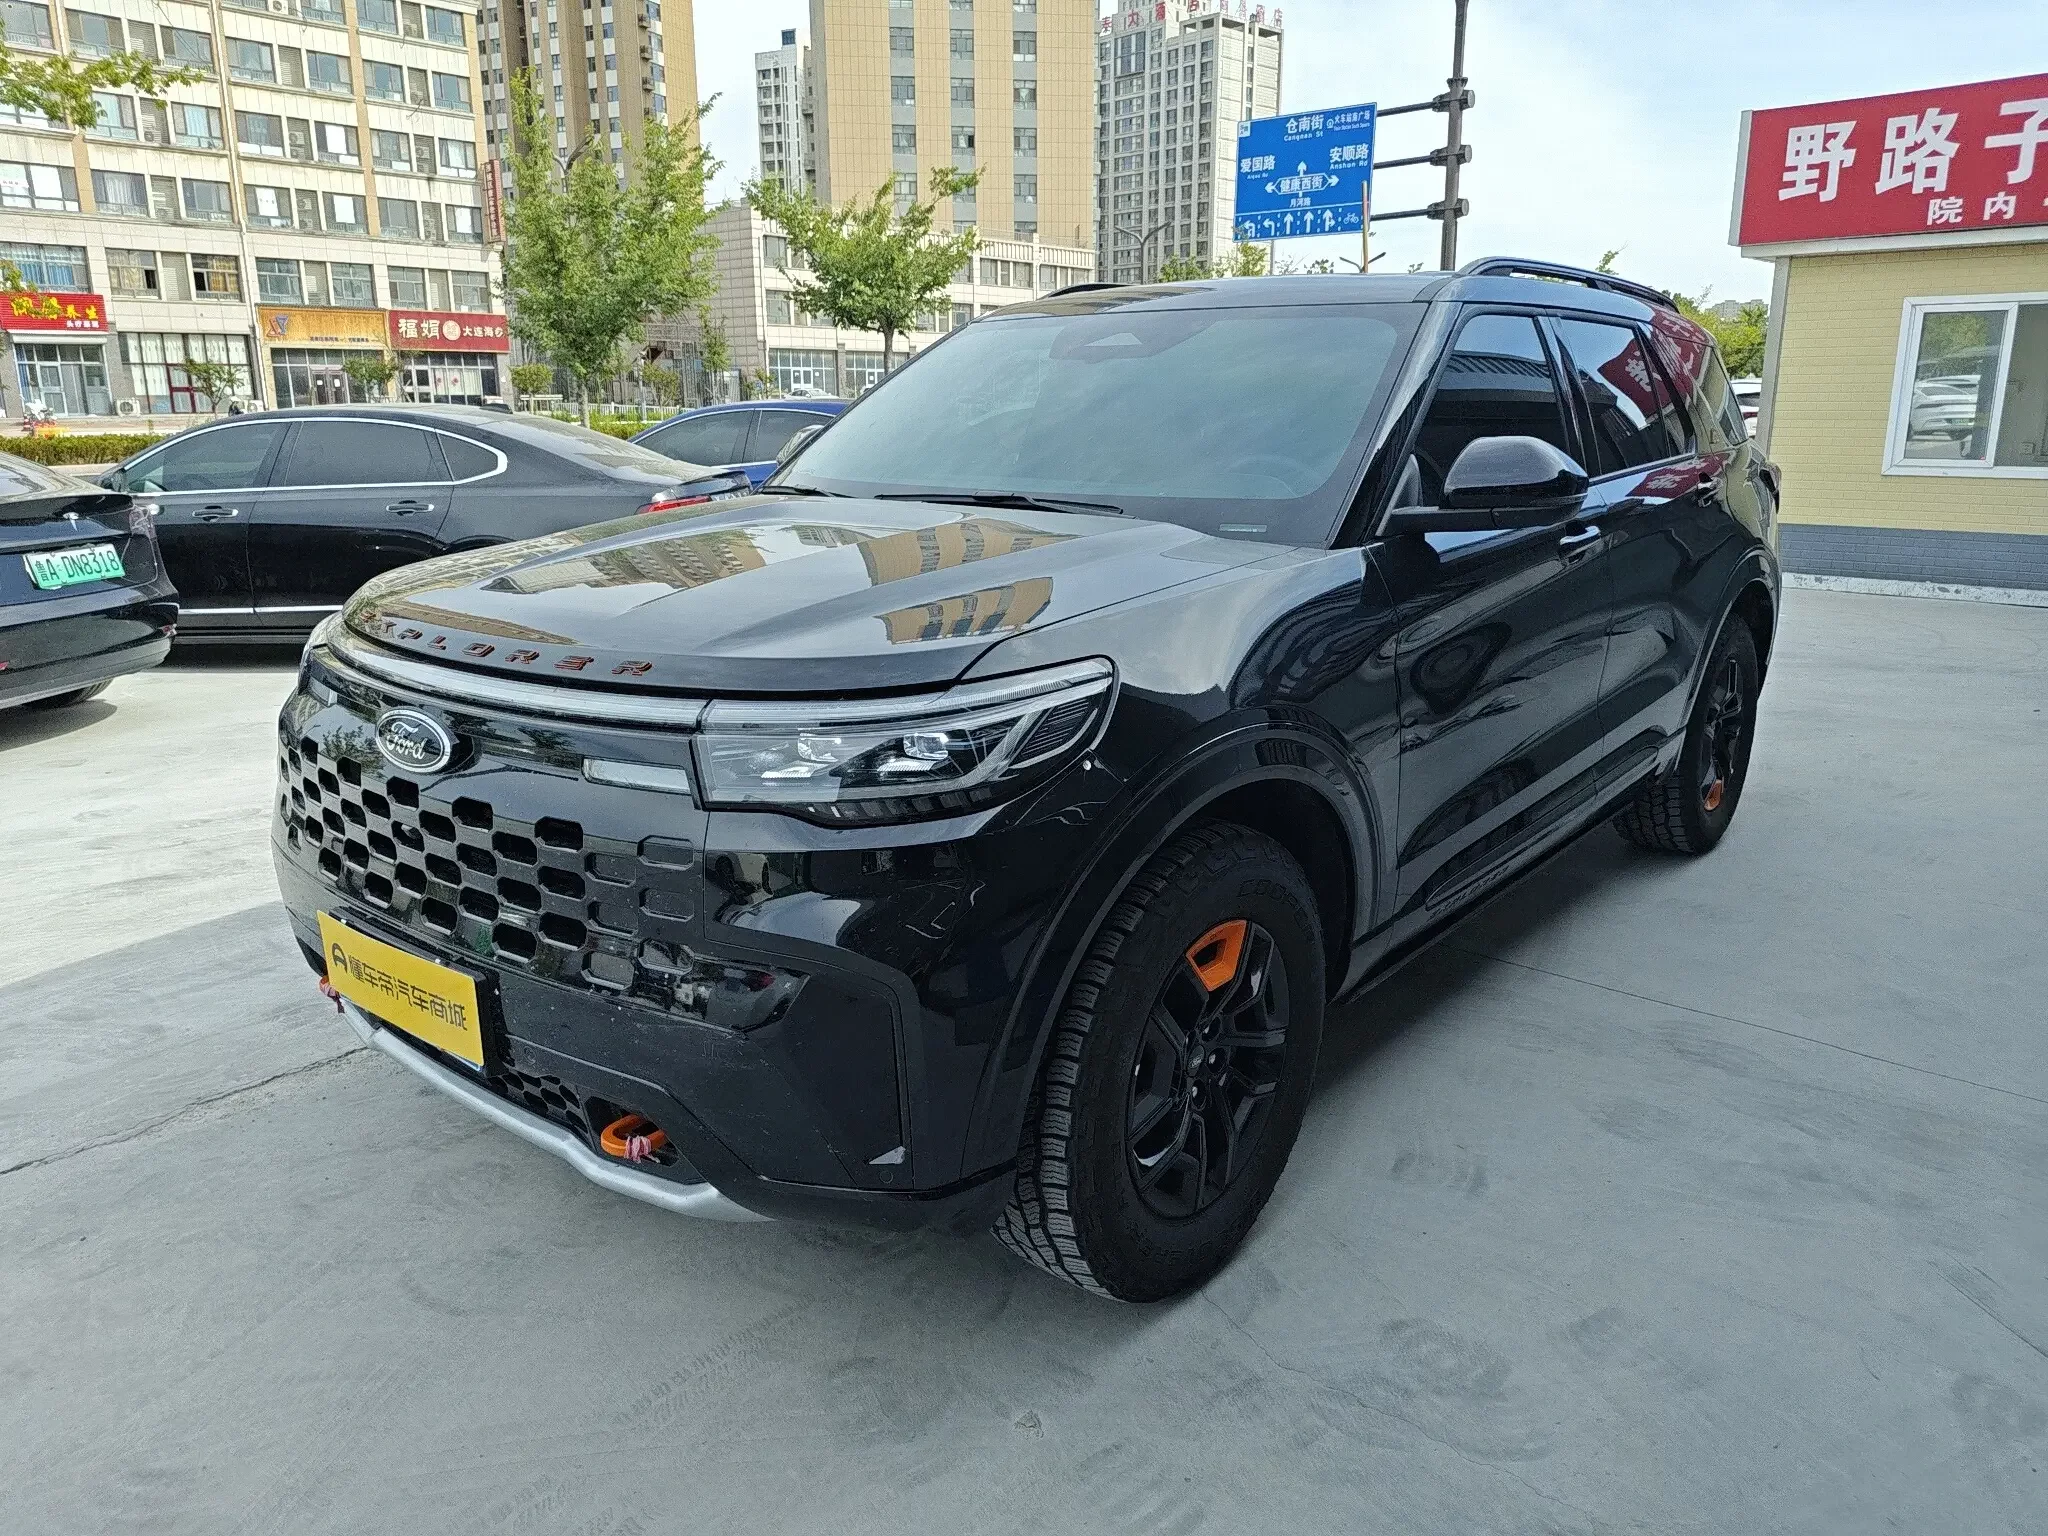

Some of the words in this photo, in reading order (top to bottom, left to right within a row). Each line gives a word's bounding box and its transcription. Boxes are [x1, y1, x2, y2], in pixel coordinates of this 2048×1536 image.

[1286, 114, 1324, 134] 仓南街
[1329, 143, 1369, 163] 安顺路
[1778, 97, 2048, 202] 野路子
[1240, 155, 1276, 173] 爱国路
[1280, 175, 1322, 193] 健康西街
[1927, 191, 2048, 225] 院内
[398, 319, 440, 340] 福娟
[386, 721, 428, 760] Ford
[348, 955, 468, 1031] 懂车帝汽车商城
